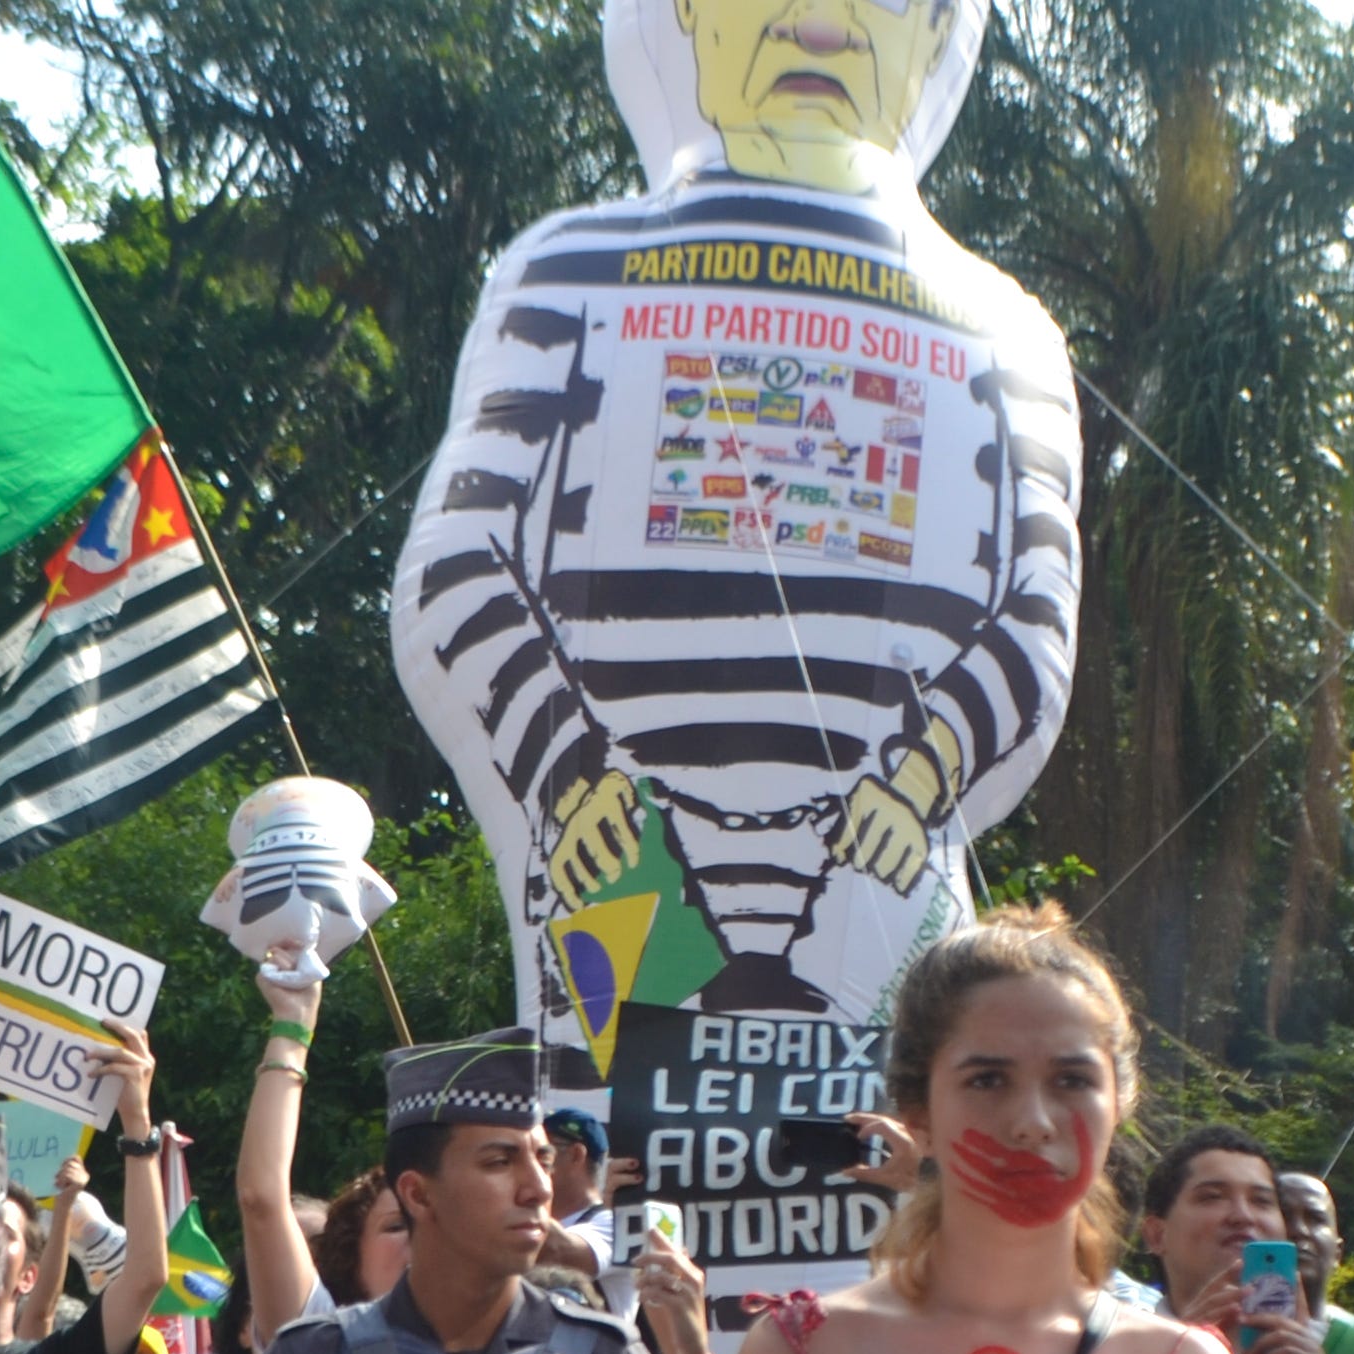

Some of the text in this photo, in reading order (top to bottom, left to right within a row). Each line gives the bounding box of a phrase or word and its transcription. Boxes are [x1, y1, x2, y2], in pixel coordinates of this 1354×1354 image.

[623, 242, 759, 284] PARTIDO
[621, 304, 966, 383] MEU PARTIDO SOU EU
[718, 355, 759, 372] PSL
[786, 483, 830, 507] PRB
[648, 522, 675, 539] 22
[775, 519, 825, 545] psd
[690, 1014, 882, 1069] ABAIX
[652, 1067, 754, 1115] LEI
